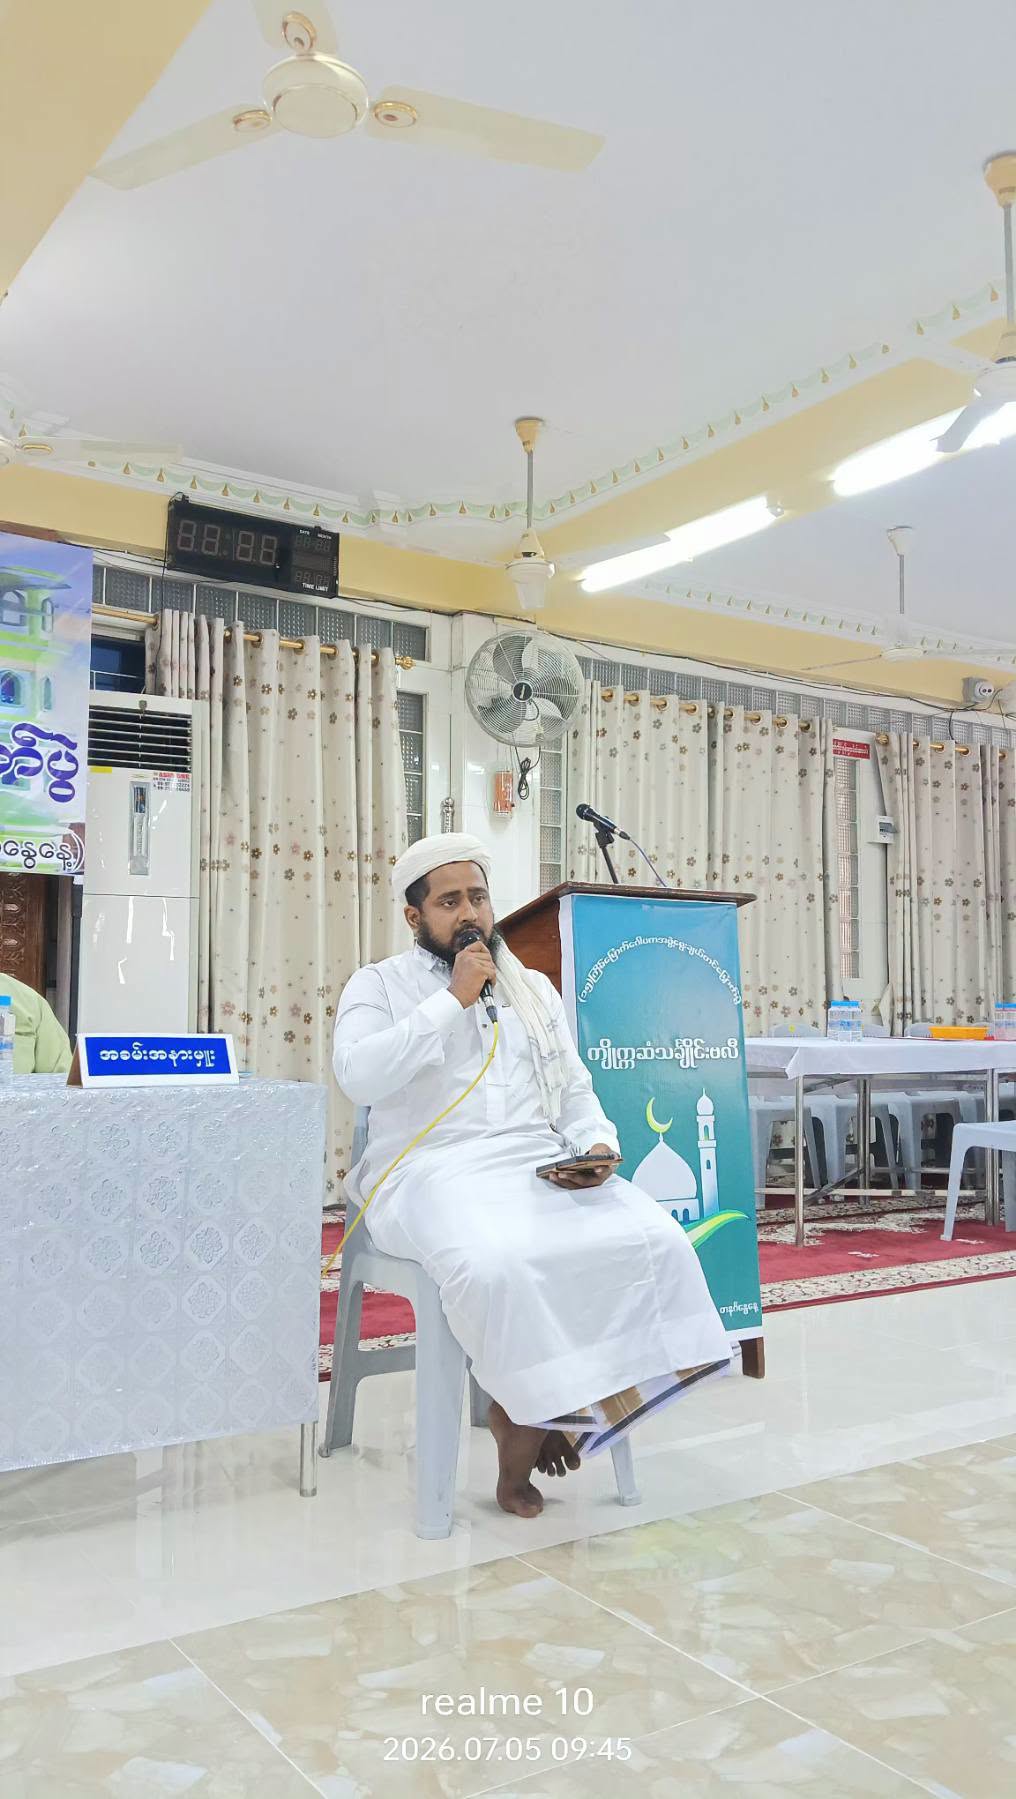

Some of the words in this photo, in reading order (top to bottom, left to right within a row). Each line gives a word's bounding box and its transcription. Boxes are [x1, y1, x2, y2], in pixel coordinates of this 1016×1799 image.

[302, 582, 315, 590] TIME
[99, 1041, 215, 1068] အခမ်းအနားမှူး
